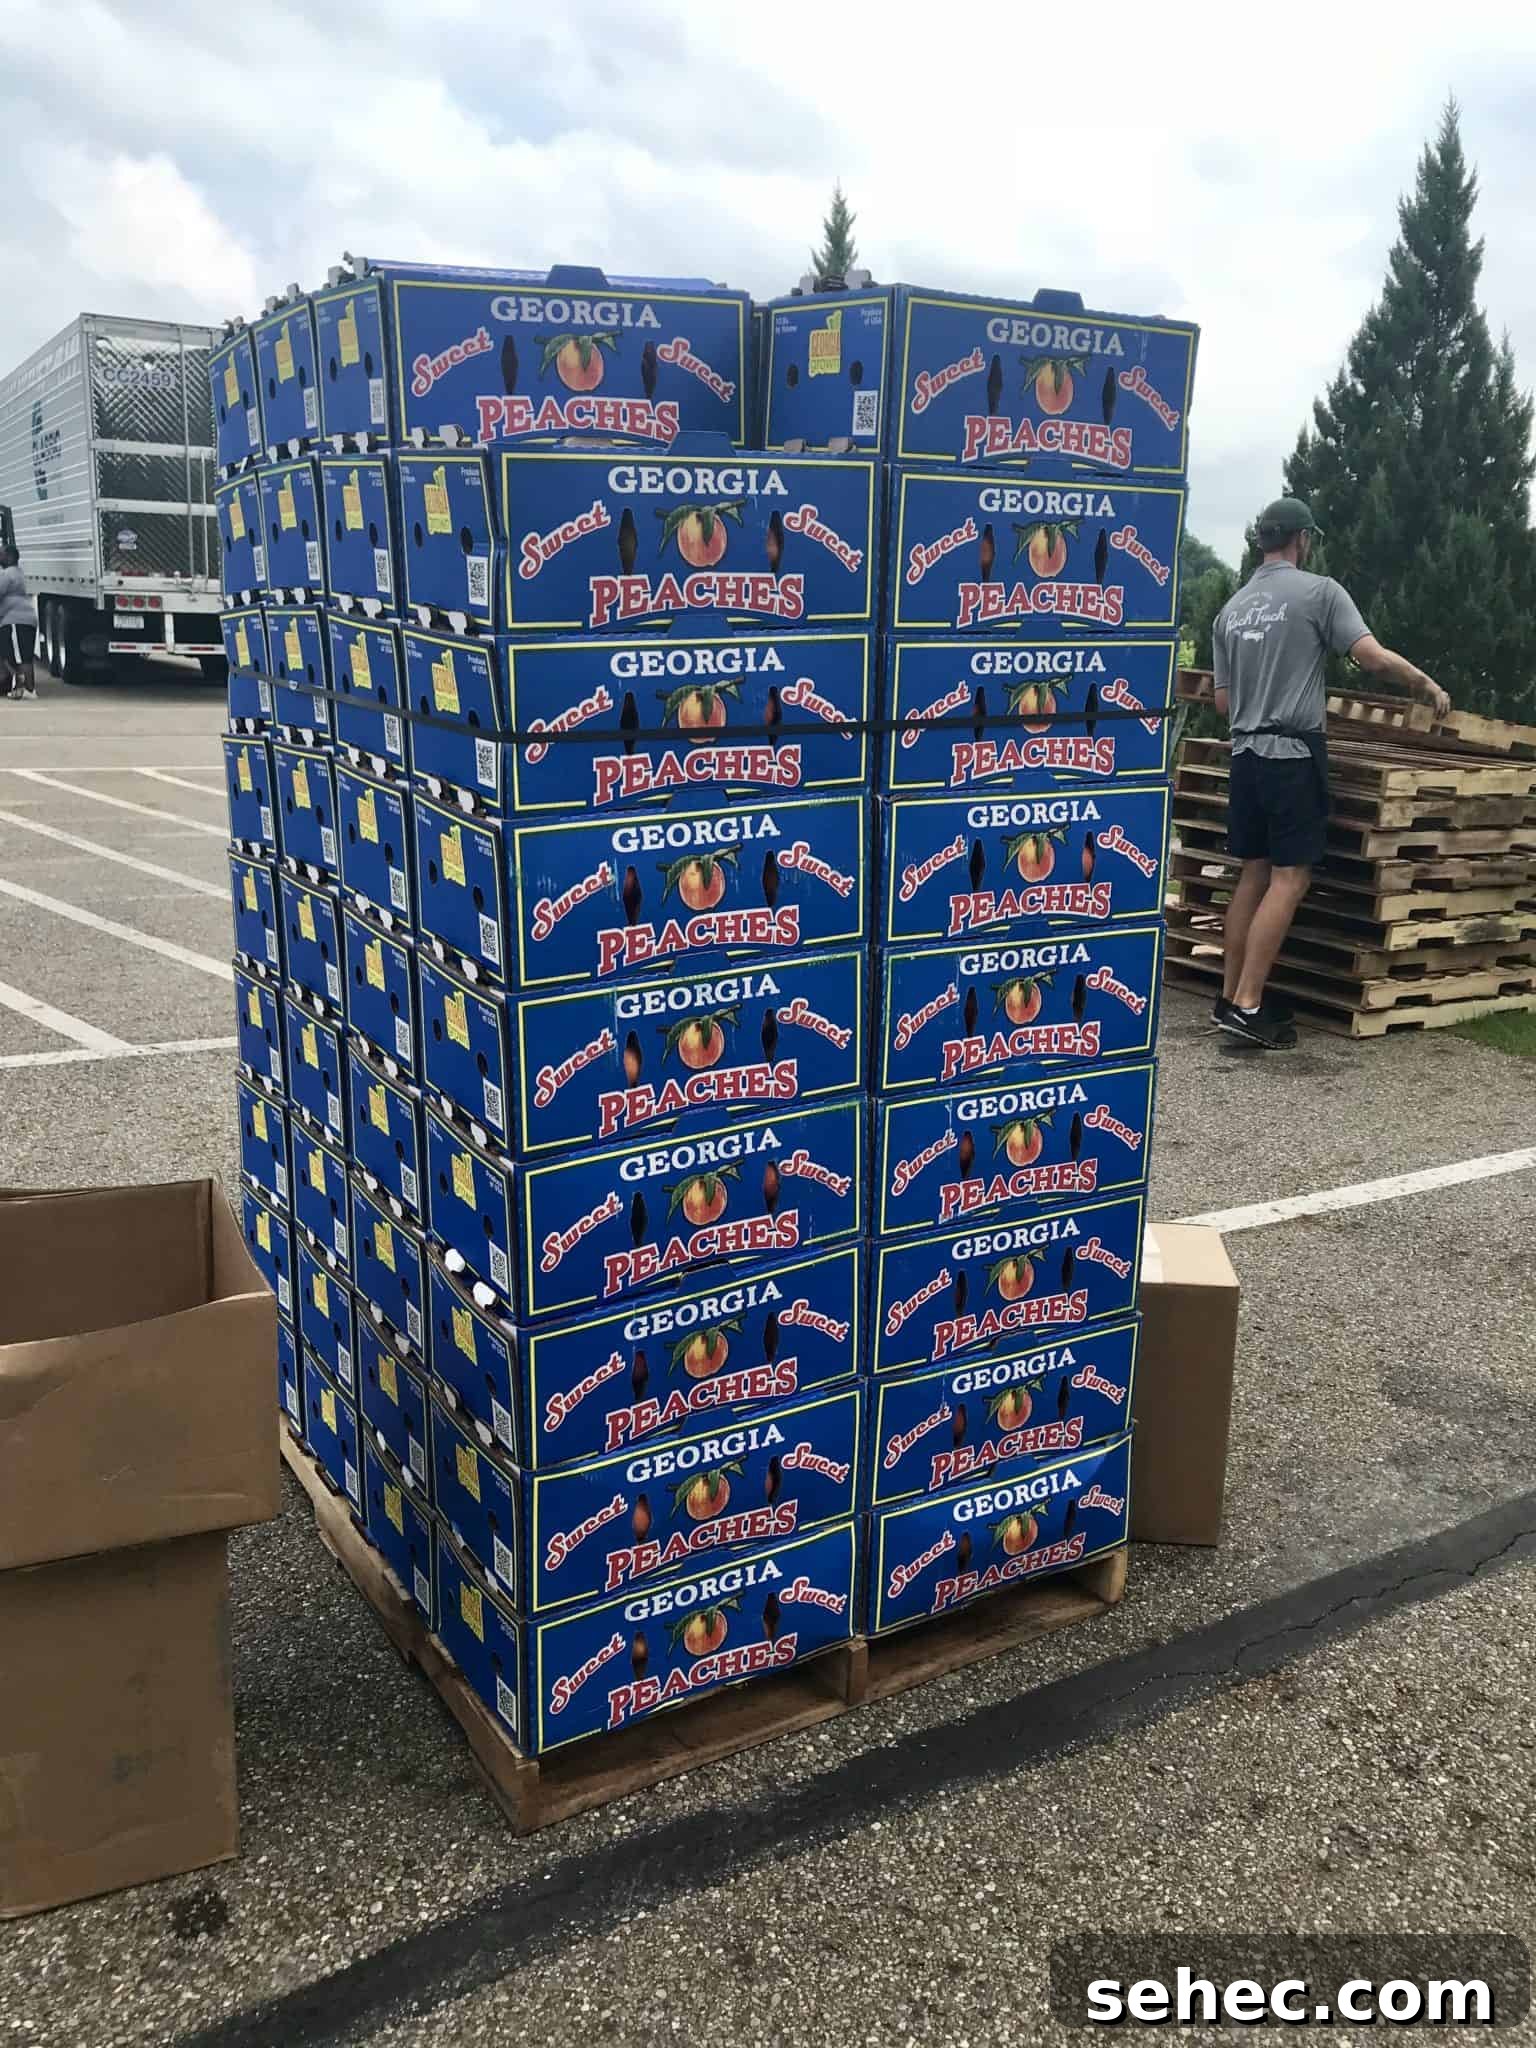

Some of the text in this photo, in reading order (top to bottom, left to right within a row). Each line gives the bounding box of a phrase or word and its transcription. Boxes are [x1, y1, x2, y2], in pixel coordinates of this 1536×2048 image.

[490, 297, 662, 328] GEORGIA
[986, 317, 1124, 357] GEORGIA
[103, 367, 171, 387] CC2459
[412, 327, 494, 396] Sweet
[657, 337, 736, 402] Sweet
[912, 347, 985, 414] Sweet
[476, 395, 680, 444] PEACHES
[1118, 366, 1180, 431] Sweet
[962, 415, 1132, 469] PEACHES
[608, 465, 788, 495] GEORGIA
[978, 487, 1115, 518] GEORGIA
[519, 500, 611, 580] Sweet
[784, 504, 863, 572] Sweet
[906, 518, 978, 585] Sweet
[1110, 524, 1170, 586] Sweet
[590, 572, 804, 628] PEACHES
[957, 582, 1124, 628] PEACHES
[610, 647, 785, 678] GEORGIA
[970, 650, 1106, 675] GEORGIA
[593, 744, 801, 806] PEACHES
[950, 736, 1115, 787] PEACHES
[612, 814, 780, 853] GEORGIA
[967, 800, 1100, 828] GEORGIA
[778, 841, 855, 897] Sweet
[899, 834, 967, 901] Sweet
[1097, 825, 1158, 878] Sweet
[532, 861, 615, 940] Sweet
[948, 882, 1112, 937] PEACHES
[598, 904, 800, 976] PEACHES
[959, 943, 1091, 976] GEORGIA
[615, 973, 780, 1019] GEORGIA
[895, 983, 960, 1050] Sweet
[1086, 966, 1147, 1015] Sweet
[776, 998, 852, 1050] Sweet
[941, 1020, 1100, 1082] PEACHES
[535, 1028, 617, 1108] Sweet
[599, 1059, 797, 1138] PEACHES
[957, 1083, 1088, 1121] GEORGIA
[1084, 1105, 1143, 1151] Sweet
[619, 1127, 781, 1181] GEORGIA
[779, 1149, 851, 1197] Sweet
[891, 1129, 958, 1197] Sweet
[939, 1158, 1098, 1223] PEACHES
[541, 1191, 623, 1272] Sweet
[604, 1209, 799, 1296] PEACHES
[951, 1218, 1080, 1261] GEORGIA
[1076, 1236, 1132, 1279] Sweet
[623, 1280, 783, 1341] GEORGIA
[778, 1298, 849, 1343] Sweet
[885, 1268, 952, 1337] Sweet
[932, 1289, 1088, 1362] PEACHES
[544, 1351, 625, 1432] Sweet
[952, 1348, 1076, 1395] GEORGIA
[1072, 1365, 1127, 1405] Sweet
[605, 1357, 797, 1452] PEACHES
[626, 1423, 785, 1483] GEORGIA
[782, 1442, 849, 1484] Sweet
[883, 1402, 952, 1469] Sweet
[929, 1416, 1084, 1491] PEACHES
[953, 1469, 1082, 1523] GEORGIA
[1078, 1485, 1124, 1517] Sweet
[545, 1494, 627, 1571] Sweet
[605, 1500, 798, 1592] PEACHES
[624, 1559, 783, 1622] GEORGIA
[888, 1530, 956, 1598] Sweet
[931, 1532, 1086, 1615] PEACHES
[779, 1576, 847, 1616] Sweet
[550, 1632, 625, 1714] Sweet
[608, 1633, 798, 1729] PEACHES
